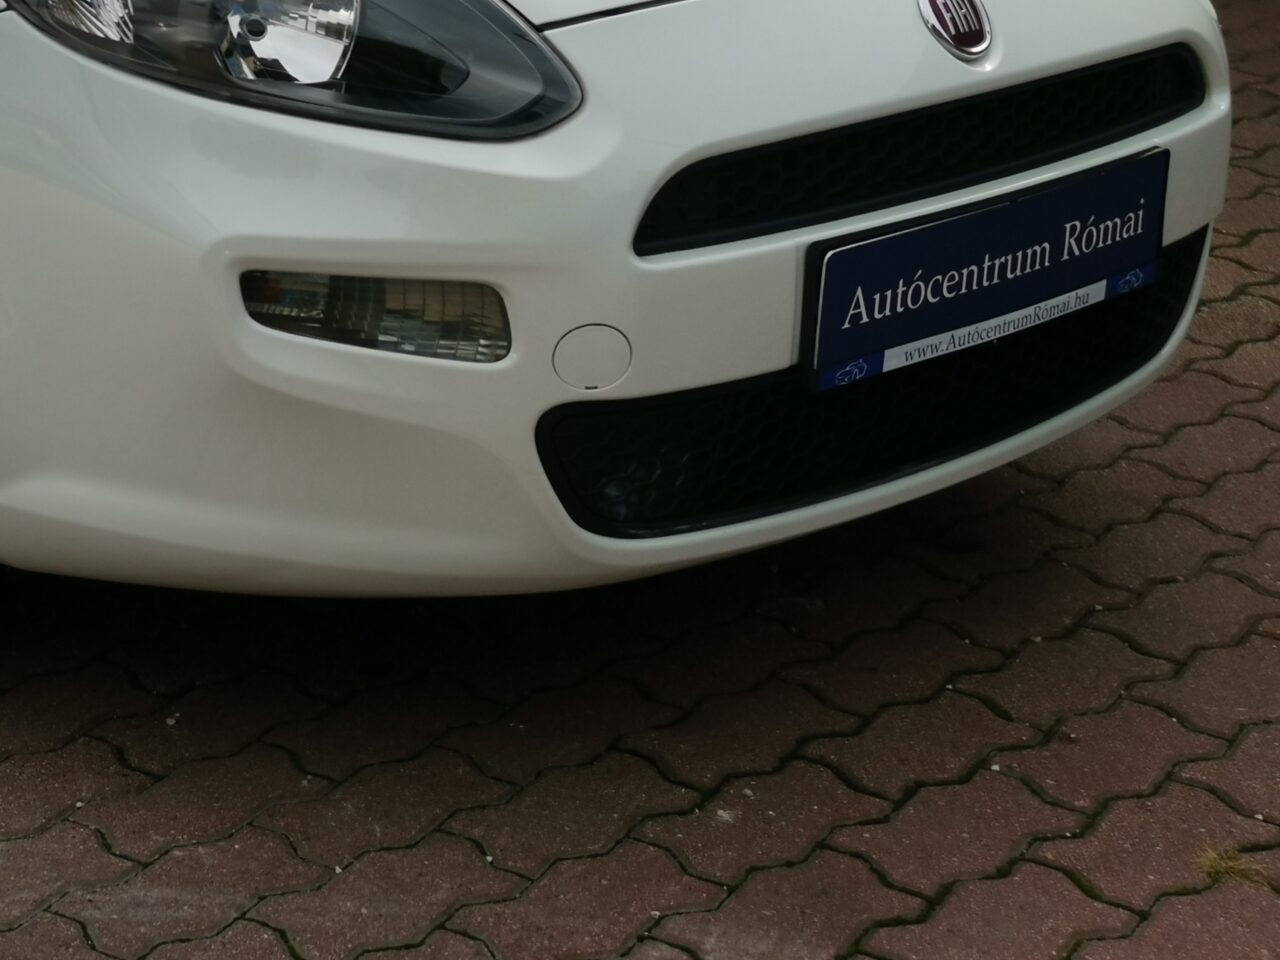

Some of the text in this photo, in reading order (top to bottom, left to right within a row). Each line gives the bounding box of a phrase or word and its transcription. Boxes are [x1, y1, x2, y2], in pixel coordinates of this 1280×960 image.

[841, 197, 1145, 329] Autócentrum Római
[904, 291, 1090, 363] www.AutócentrumRómai.hu
